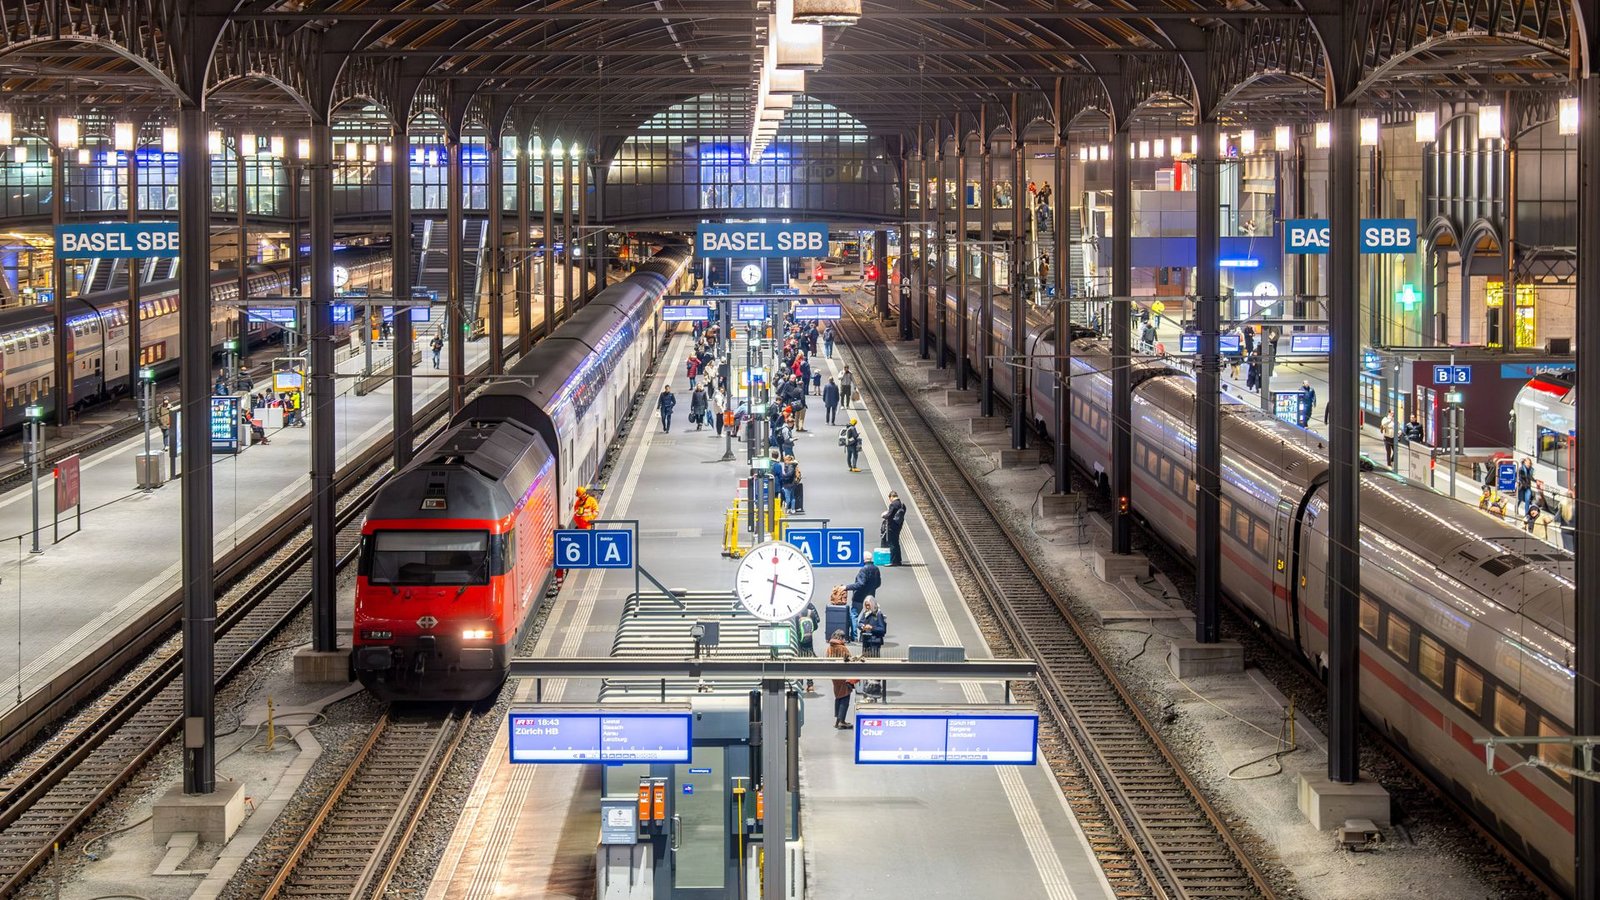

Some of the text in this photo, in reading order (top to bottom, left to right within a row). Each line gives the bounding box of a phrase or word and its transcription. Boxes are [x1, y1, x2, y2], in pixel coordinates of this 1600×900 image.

[62, 232, 132, 252] BASEL
[702, 231, 823, 251] BASEL SBB
[1291, 227, 1411, 247] BAS SBB
[1439, 371, 1448, 381] B
[1458, 371, 1466, 381] 3
[565, 542, 581, 562] 6
[604, 542, 621, 562] A
[800, 541, 814, 560] A
[837, 541, 852, 561] 5
[515, 727, 559, 735] Zürich HB
[862, 728, 884, 736] Chur
